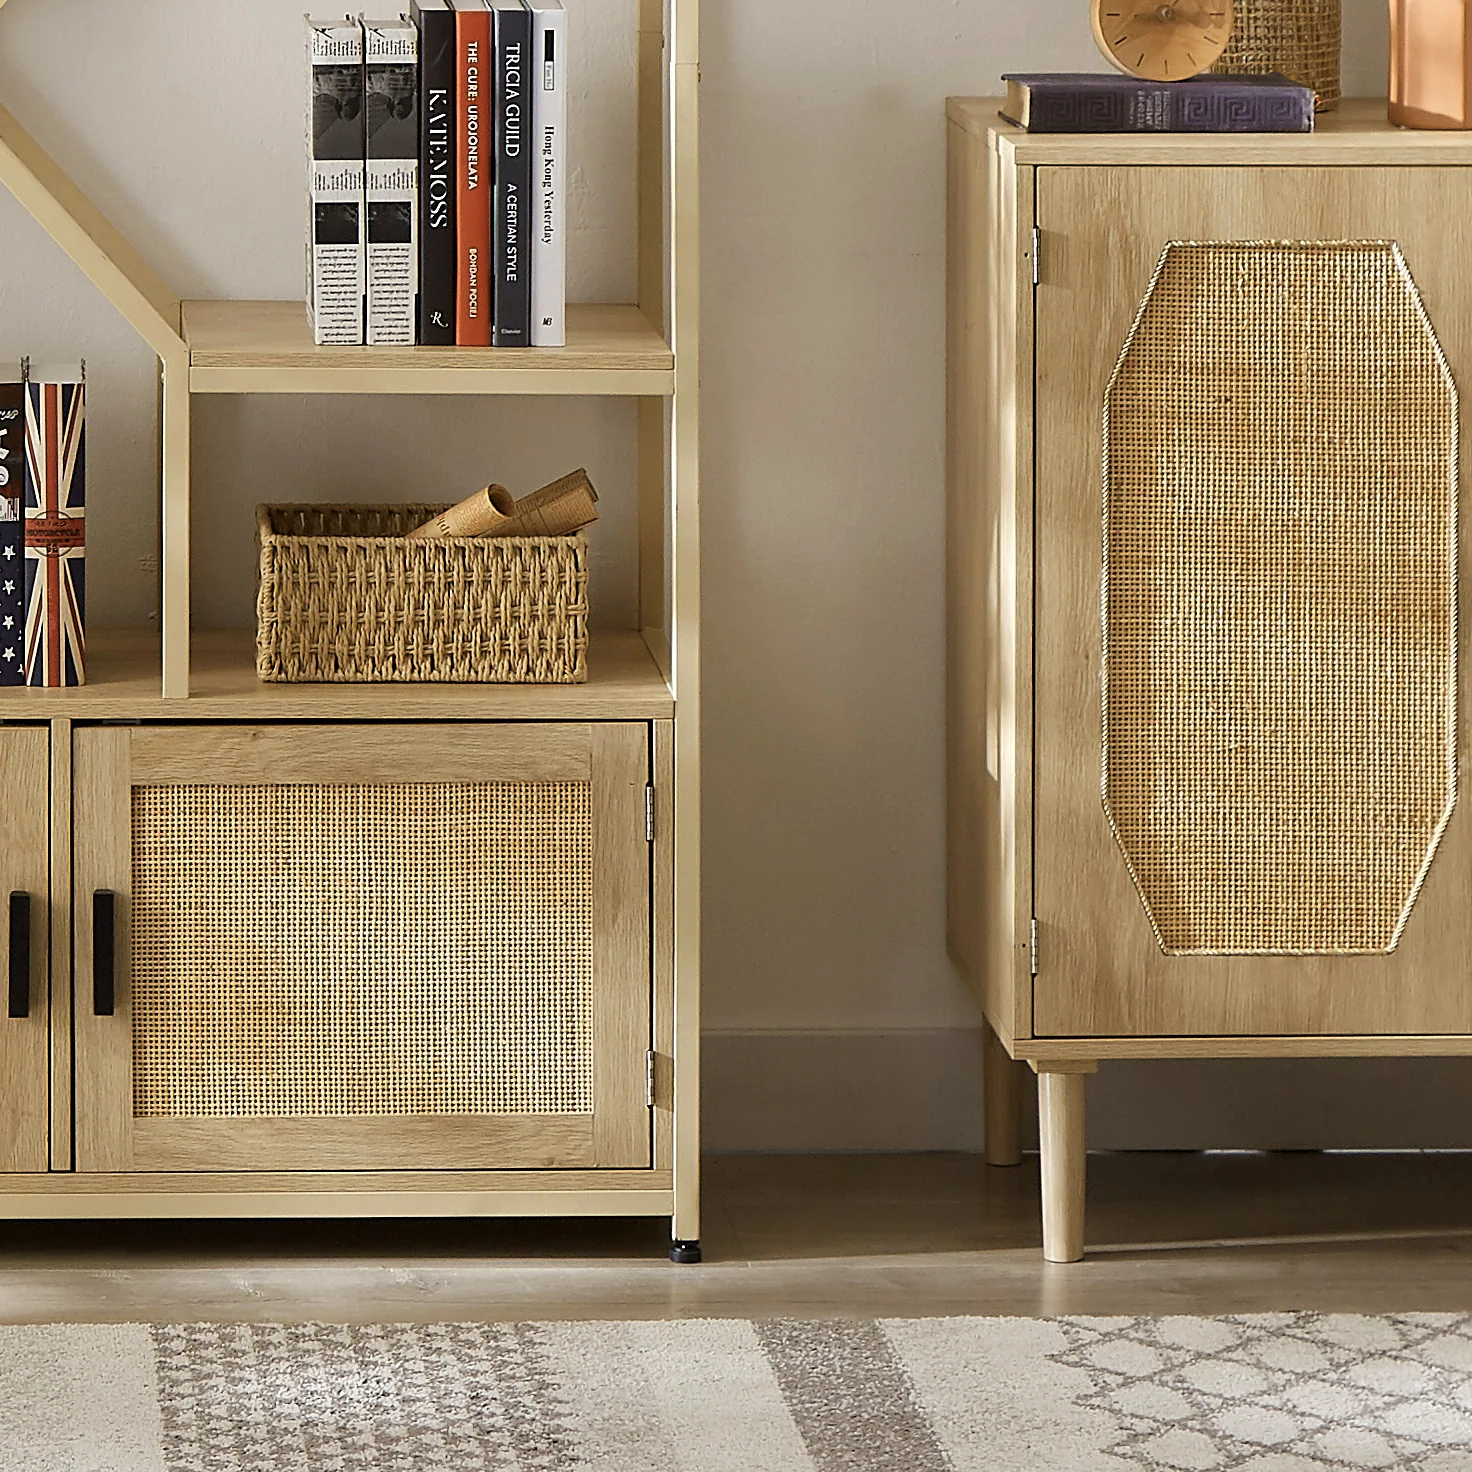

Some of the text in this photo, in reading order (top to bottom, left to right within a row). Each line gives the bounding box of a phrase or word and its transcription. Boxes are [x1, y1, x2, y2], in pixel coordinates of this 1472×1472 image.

[467, 41, 478, 63] THE
[467, 66, 478, 101] CURE:
[505, 42, 521, 157] TRICIA GUILD
[506, 183, 518, 282] A CERTIAN STYLE
[541, 126, 555, 245] Hong Kong Yesterday
